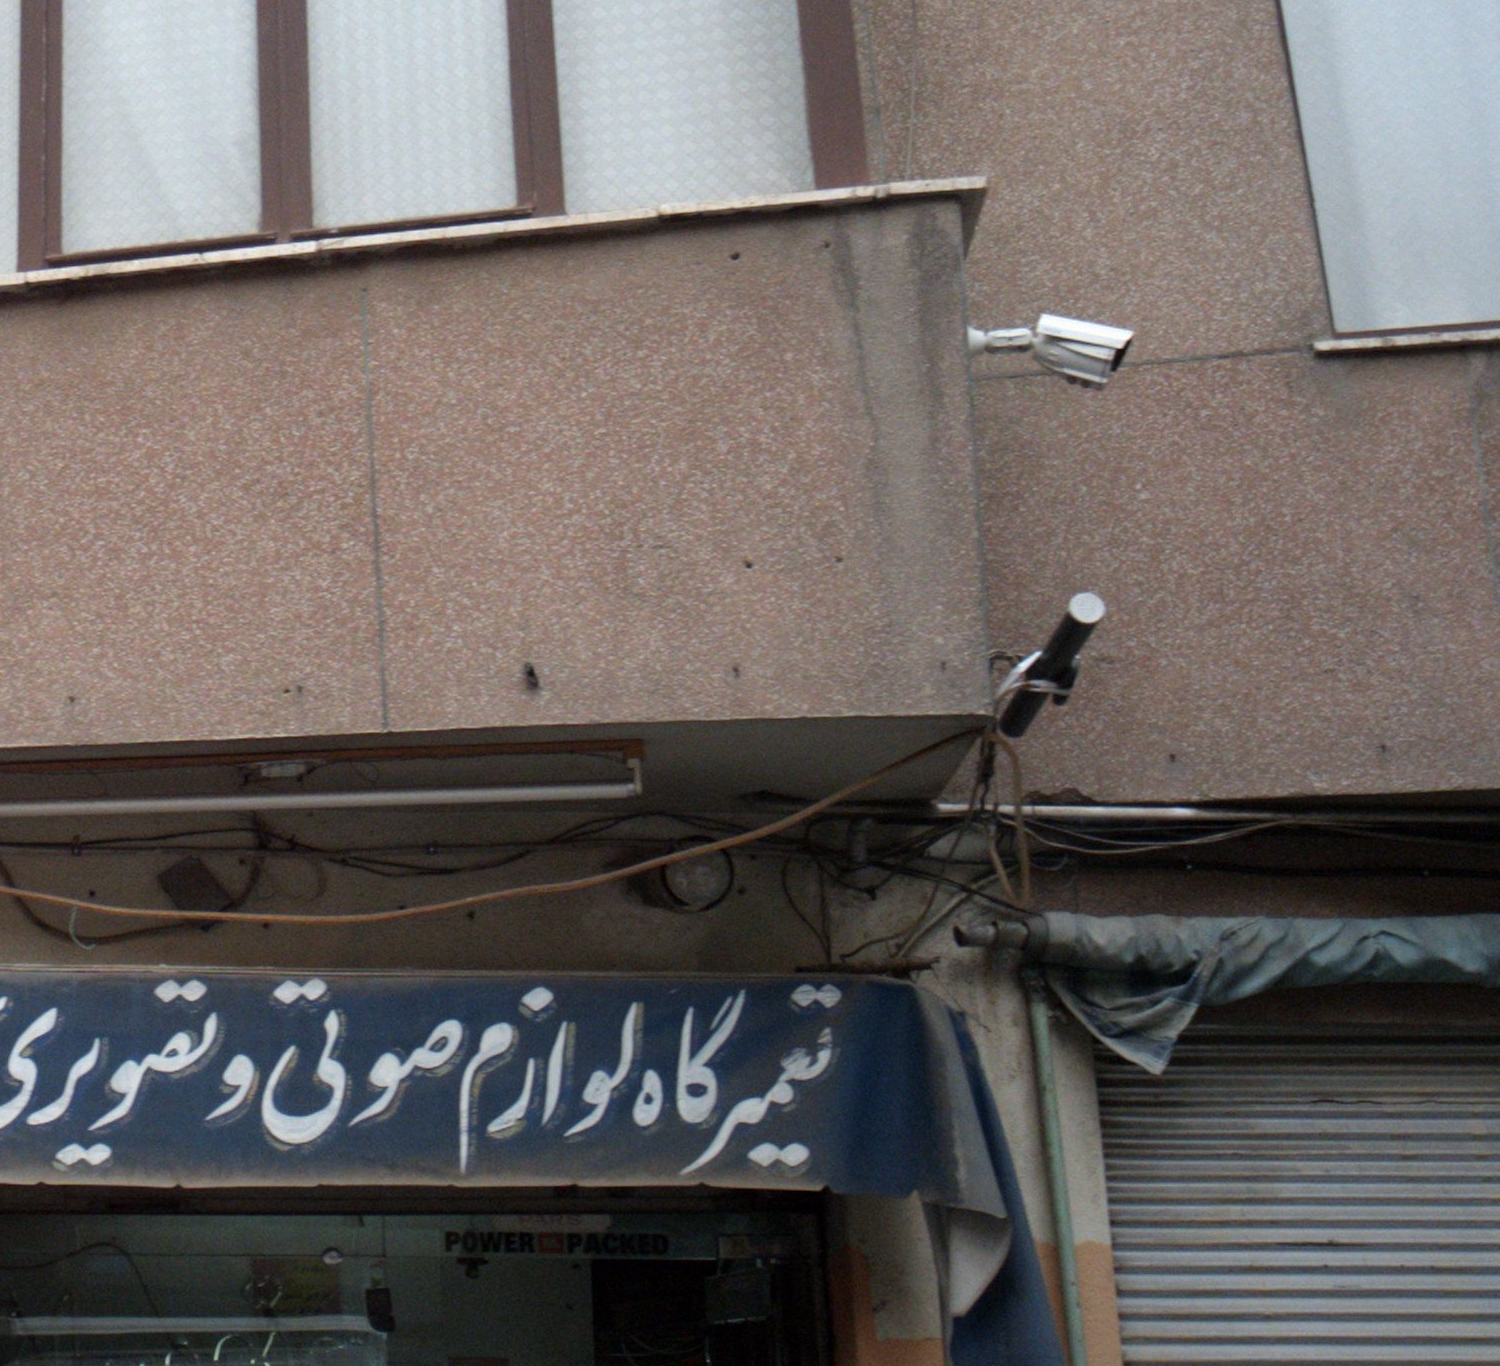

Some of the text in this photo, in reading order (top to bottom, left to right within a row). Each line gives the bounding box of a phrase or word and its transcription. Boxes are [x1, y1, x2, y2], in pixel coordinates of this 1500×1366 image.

[204, 1053, 259, 1122] و
[260, 977, 464, 1146] صوتی
[458, 985, 638, 1175] لوازم
[444, 1230, 669, 1255] POWER PACKED
